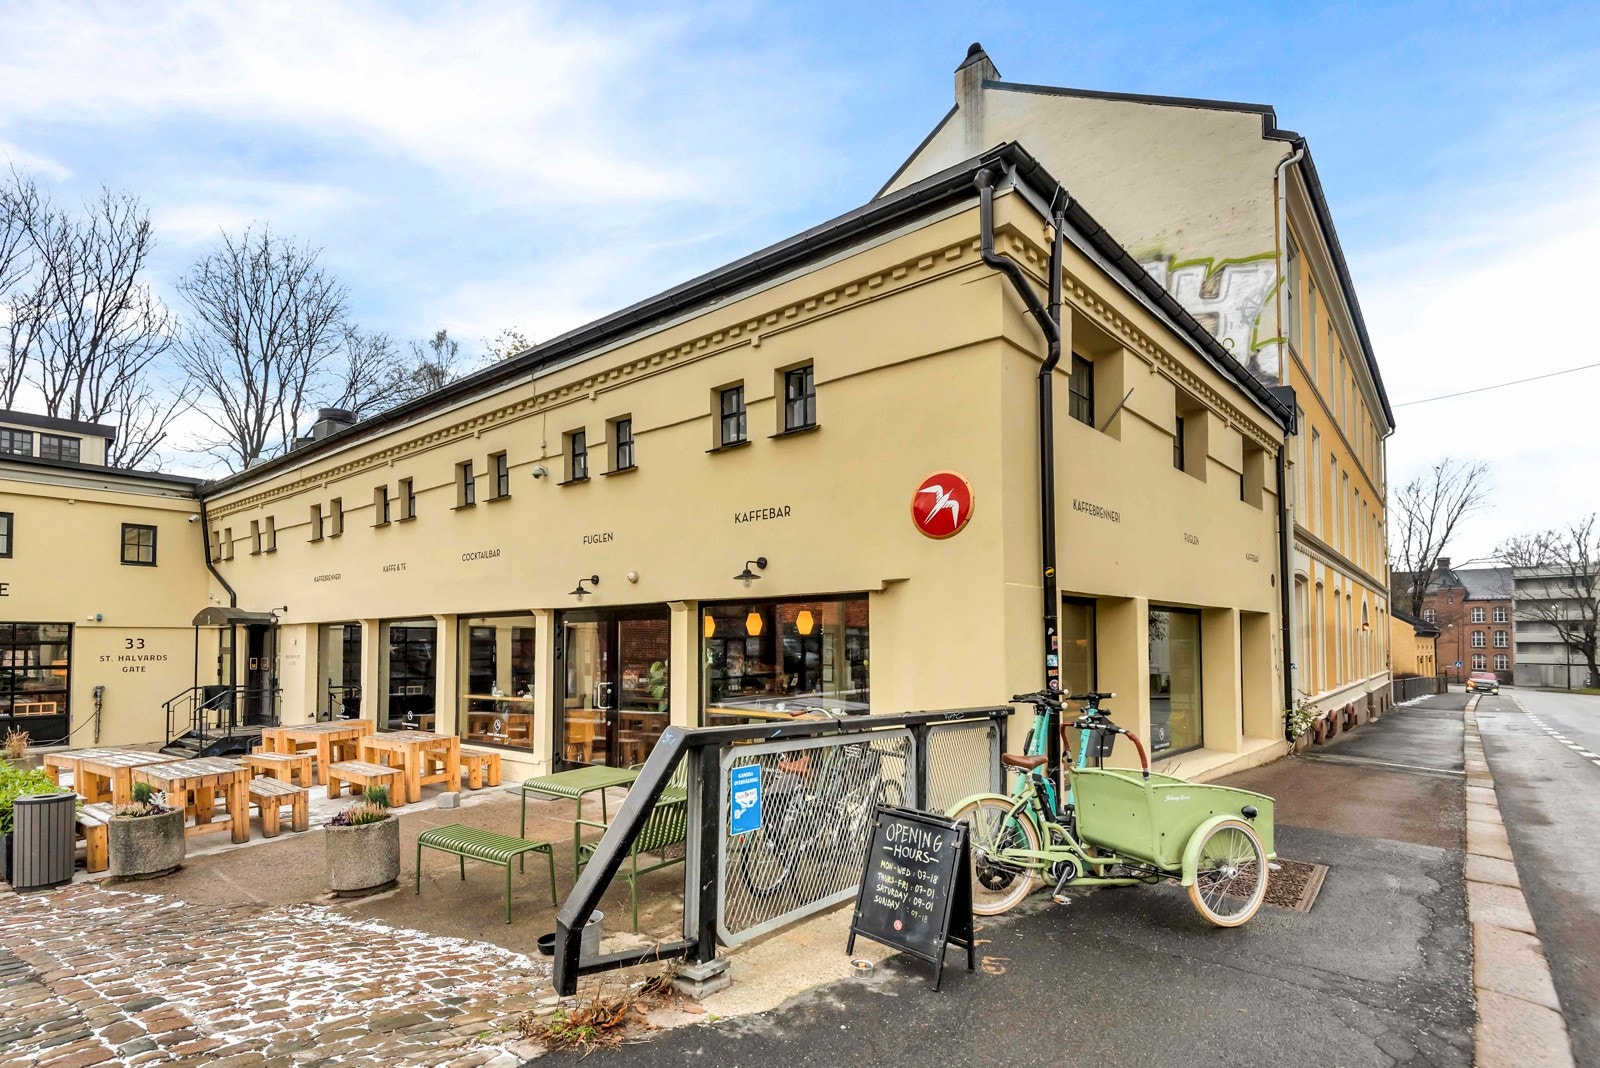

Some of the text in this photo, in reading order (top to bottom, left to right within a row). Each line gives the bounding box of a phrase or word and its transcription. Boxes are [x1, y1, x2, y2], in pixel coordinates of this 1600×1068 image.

[734, 505, 791, 524] KAFFEBAR
[1072, 498, 1121, 524] KAFFEBRENNERI
[583, 532, 614, 546] FUGLEN
[461, 548, 501, 562] COCKTAILBAR
[382, 564, 396, 573] KAFFE
[401, 562, 407, 571] TE
[125, 638, 145, 650] 33
[118, 654, 168, 662] HALVARDS
[122, 665, 146, 673] GATE
[886, 823, 943, 853] OPENING
[876, 883, 909, 903] SATURDAY
[873, 895, 901, 910] SUNDAY
